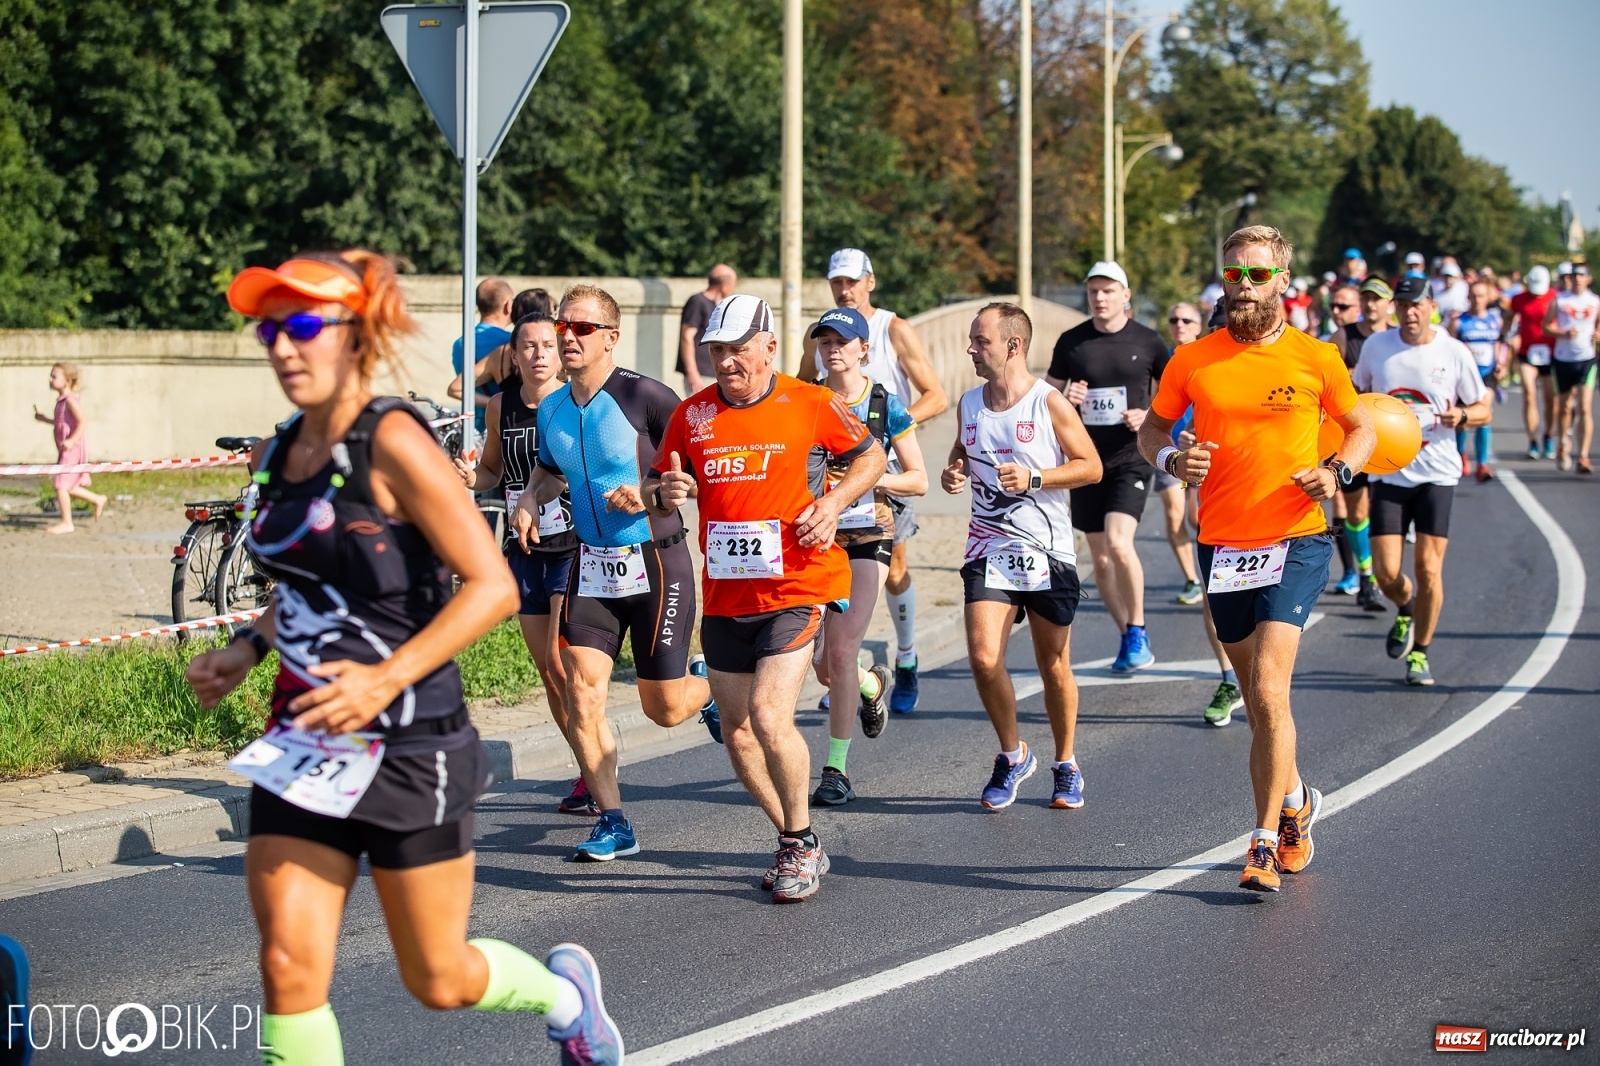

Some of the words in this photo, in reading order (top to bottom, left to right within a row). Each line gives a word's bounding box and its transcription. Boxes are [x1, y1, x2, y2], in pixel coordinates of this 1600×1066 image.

[820, 312, 854, 325] adidas
[1092, 399, 1115, 411] 266
[690, 433, 715, 443] POLSKA
[703, 445, 748, 455] ENERGETYKA
[749, 443, 786, 451] SOLARNA
[707, 473, 767, 484] www.ensol.pl
[727, 538, 763, 556] 232
[600, 561, 627, 578] 190
[1008, 555, 1036, 572] 342
[1235, 554, 1270, 572] 227
[661, 582, 680, 646] APTONIA
